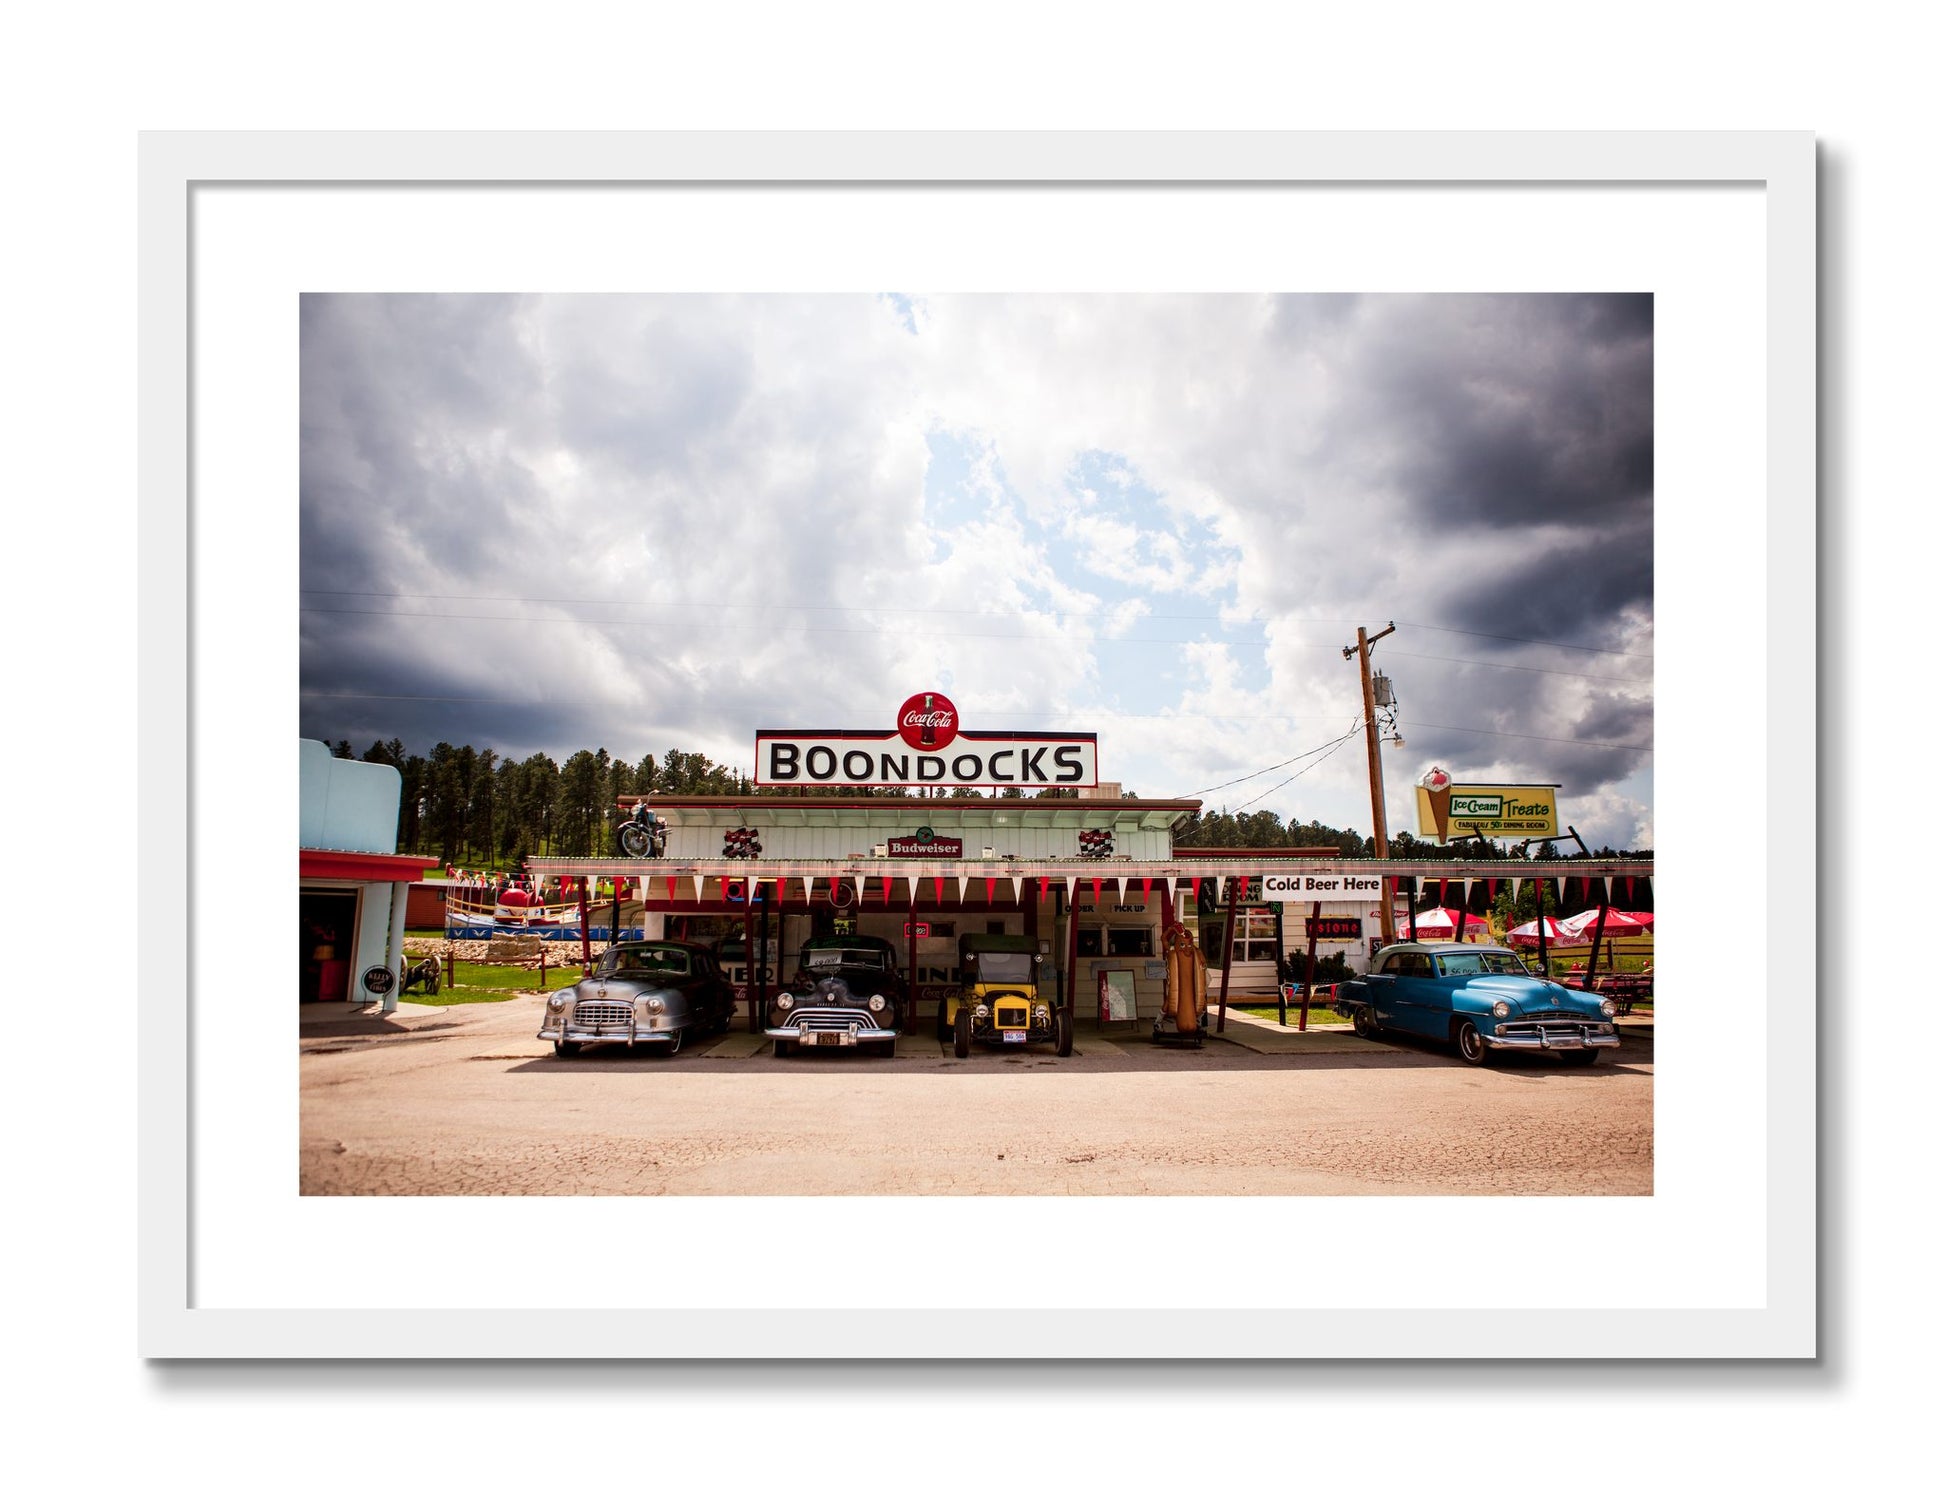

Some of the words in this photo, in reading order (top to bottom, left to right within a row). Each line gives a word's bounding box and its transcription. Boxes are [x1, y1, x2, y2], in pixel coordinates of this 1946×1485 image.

[770, 743, 1084, 782] BOONDOCKS
[1454, 800, 1467, 811] Ice
[1467, 800, 1498, 813] Cream
[1503, 799, 1549, 817] Treats
[891, 843, 958, 853] Budweiser
[1266, 878, 1300, 890] Cold
[1305, 878, 1339, 890] Beer
[1343, 878, 1379, 890] Here
